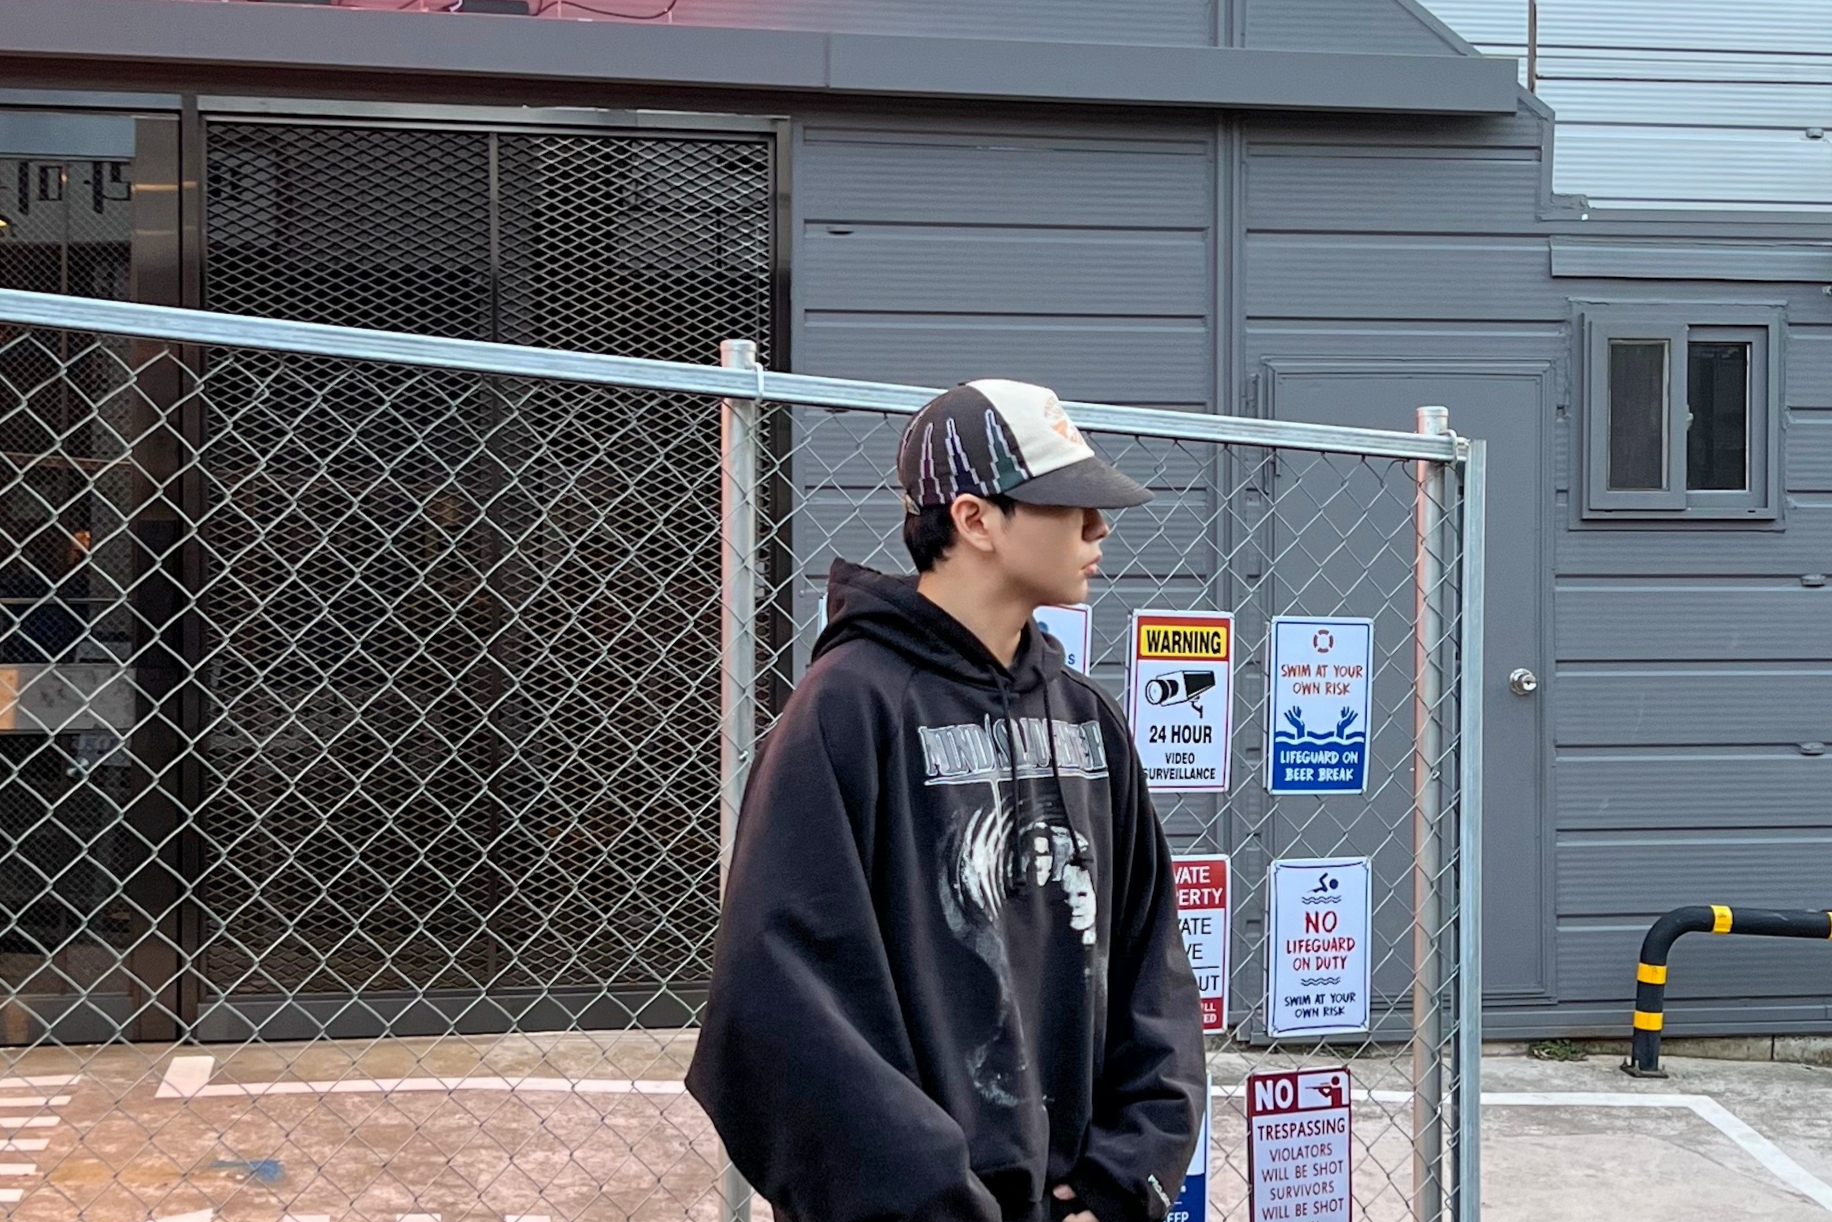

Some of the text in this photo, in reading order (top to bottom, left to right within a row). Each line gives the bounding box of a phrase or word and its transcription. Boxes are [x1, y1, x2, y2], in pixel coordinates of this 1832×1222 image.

[1146, 630, 1221, 654] WARNING
[1281, 664, 1363, 678] SWIM AT YOUR
[1293, 682, 1351, 696] OWN RISK
[1149, 725, 1212, 743] 24 HOUR
[1165, 752, 1195, 765] VIDEO
[1280, 750, 1359, 764] LIFEGUARD ON
[1284, 767, 1354, 782] BEER BREAK
[1174, 866, 1211, 885] VATE
[1305, 910, 1337, 934] NO
[1286, 937, 1356, 955] LIFEGUARD
[1293, 955, 1348, 971] ON DUTY
[1198, 975, 1220, 993] UT
[1284, 992, 1356, 1007] SWIM AT YOUR
[1295, 1006, 1345, 1019] OWN RISK
[1254, 1078, 1294, 1112] NO
[1257, 1117, 1346, 1141] TRESPASSING
[1269, 1143, 1333, 1162] VIOLATORS
[1261, 1160, 1344, 1182] WILL BE SHOT
[1269, 1180, 1335, 1200] SURVIVORS
[1262, 1197, 1344, 1220] WILL BE SHOT
